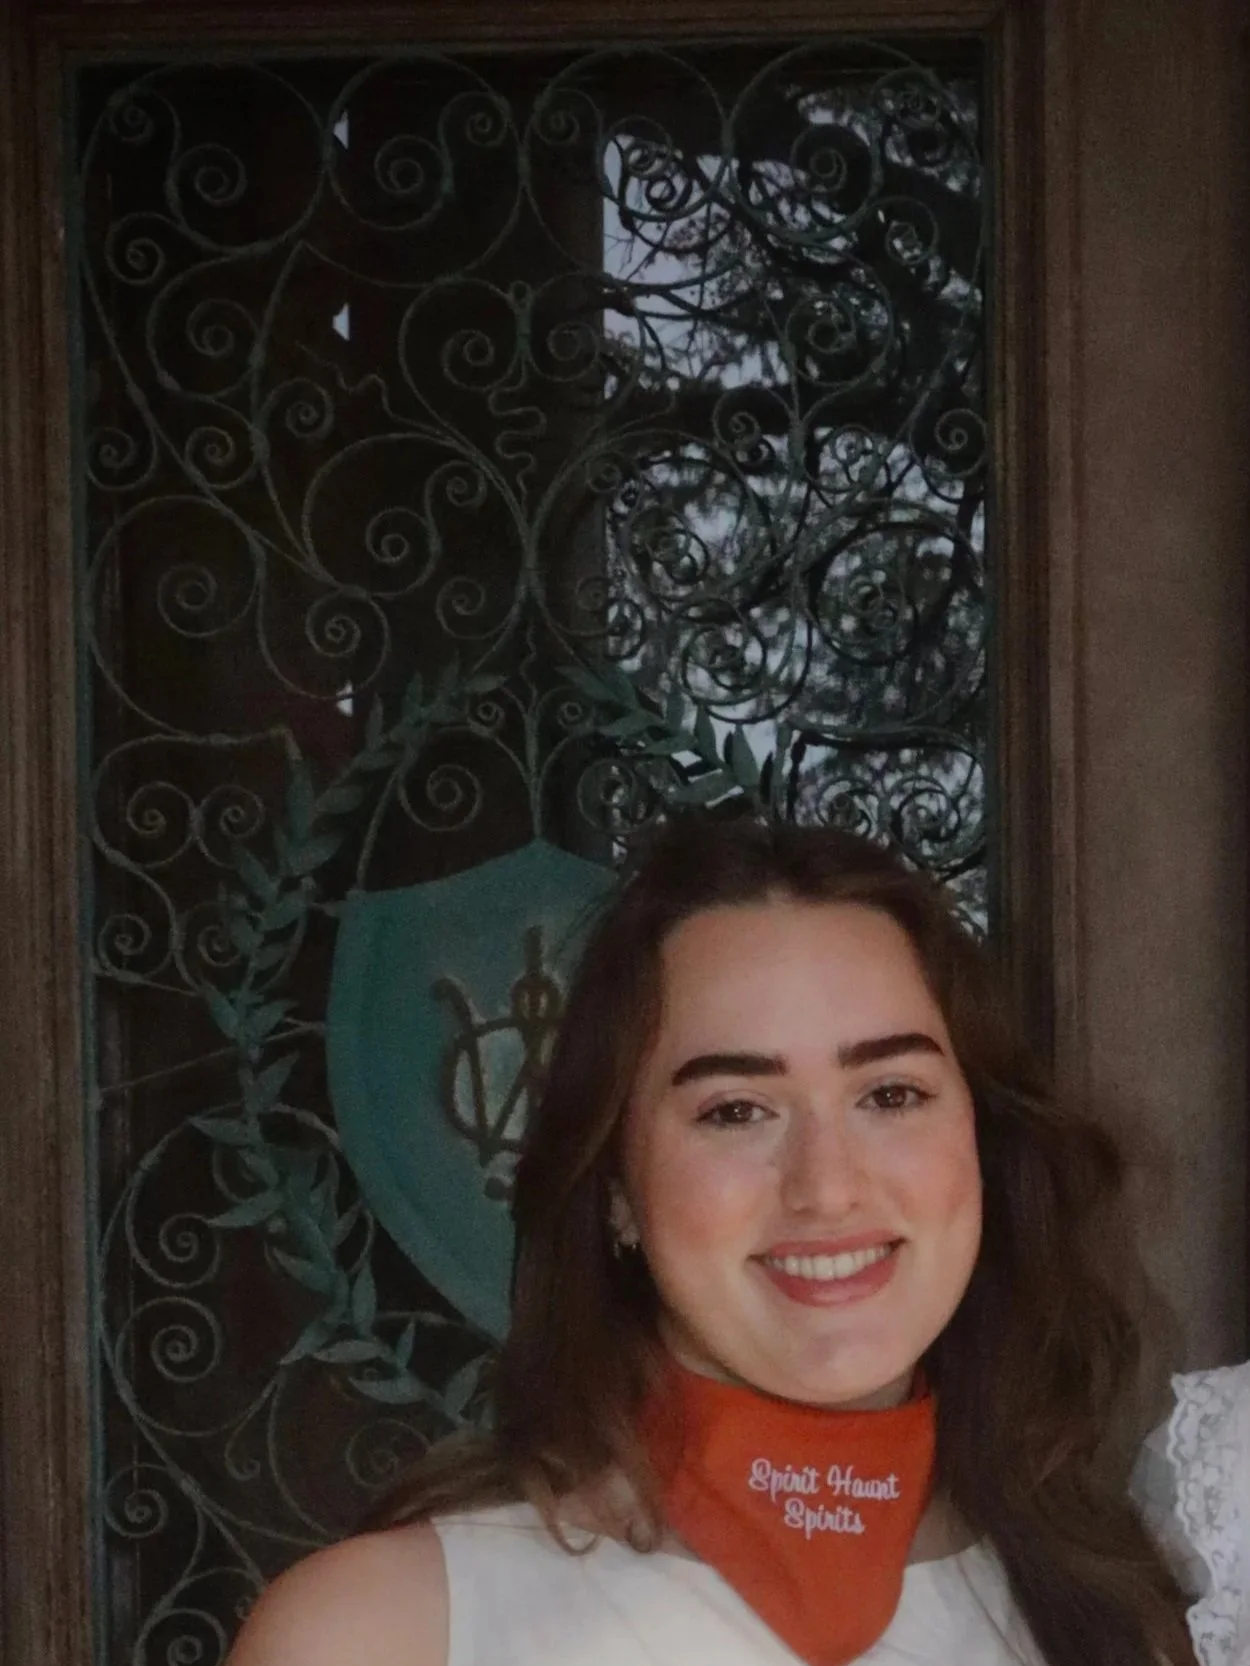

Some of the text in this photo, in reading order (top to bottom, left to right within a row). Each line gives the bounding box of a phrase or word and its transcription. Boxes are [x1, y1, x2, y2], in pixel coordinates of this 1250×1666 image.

[748, 1458, 899, 1502] Spirit Haunt
[784, 1498, 865, 1540] Spirits
